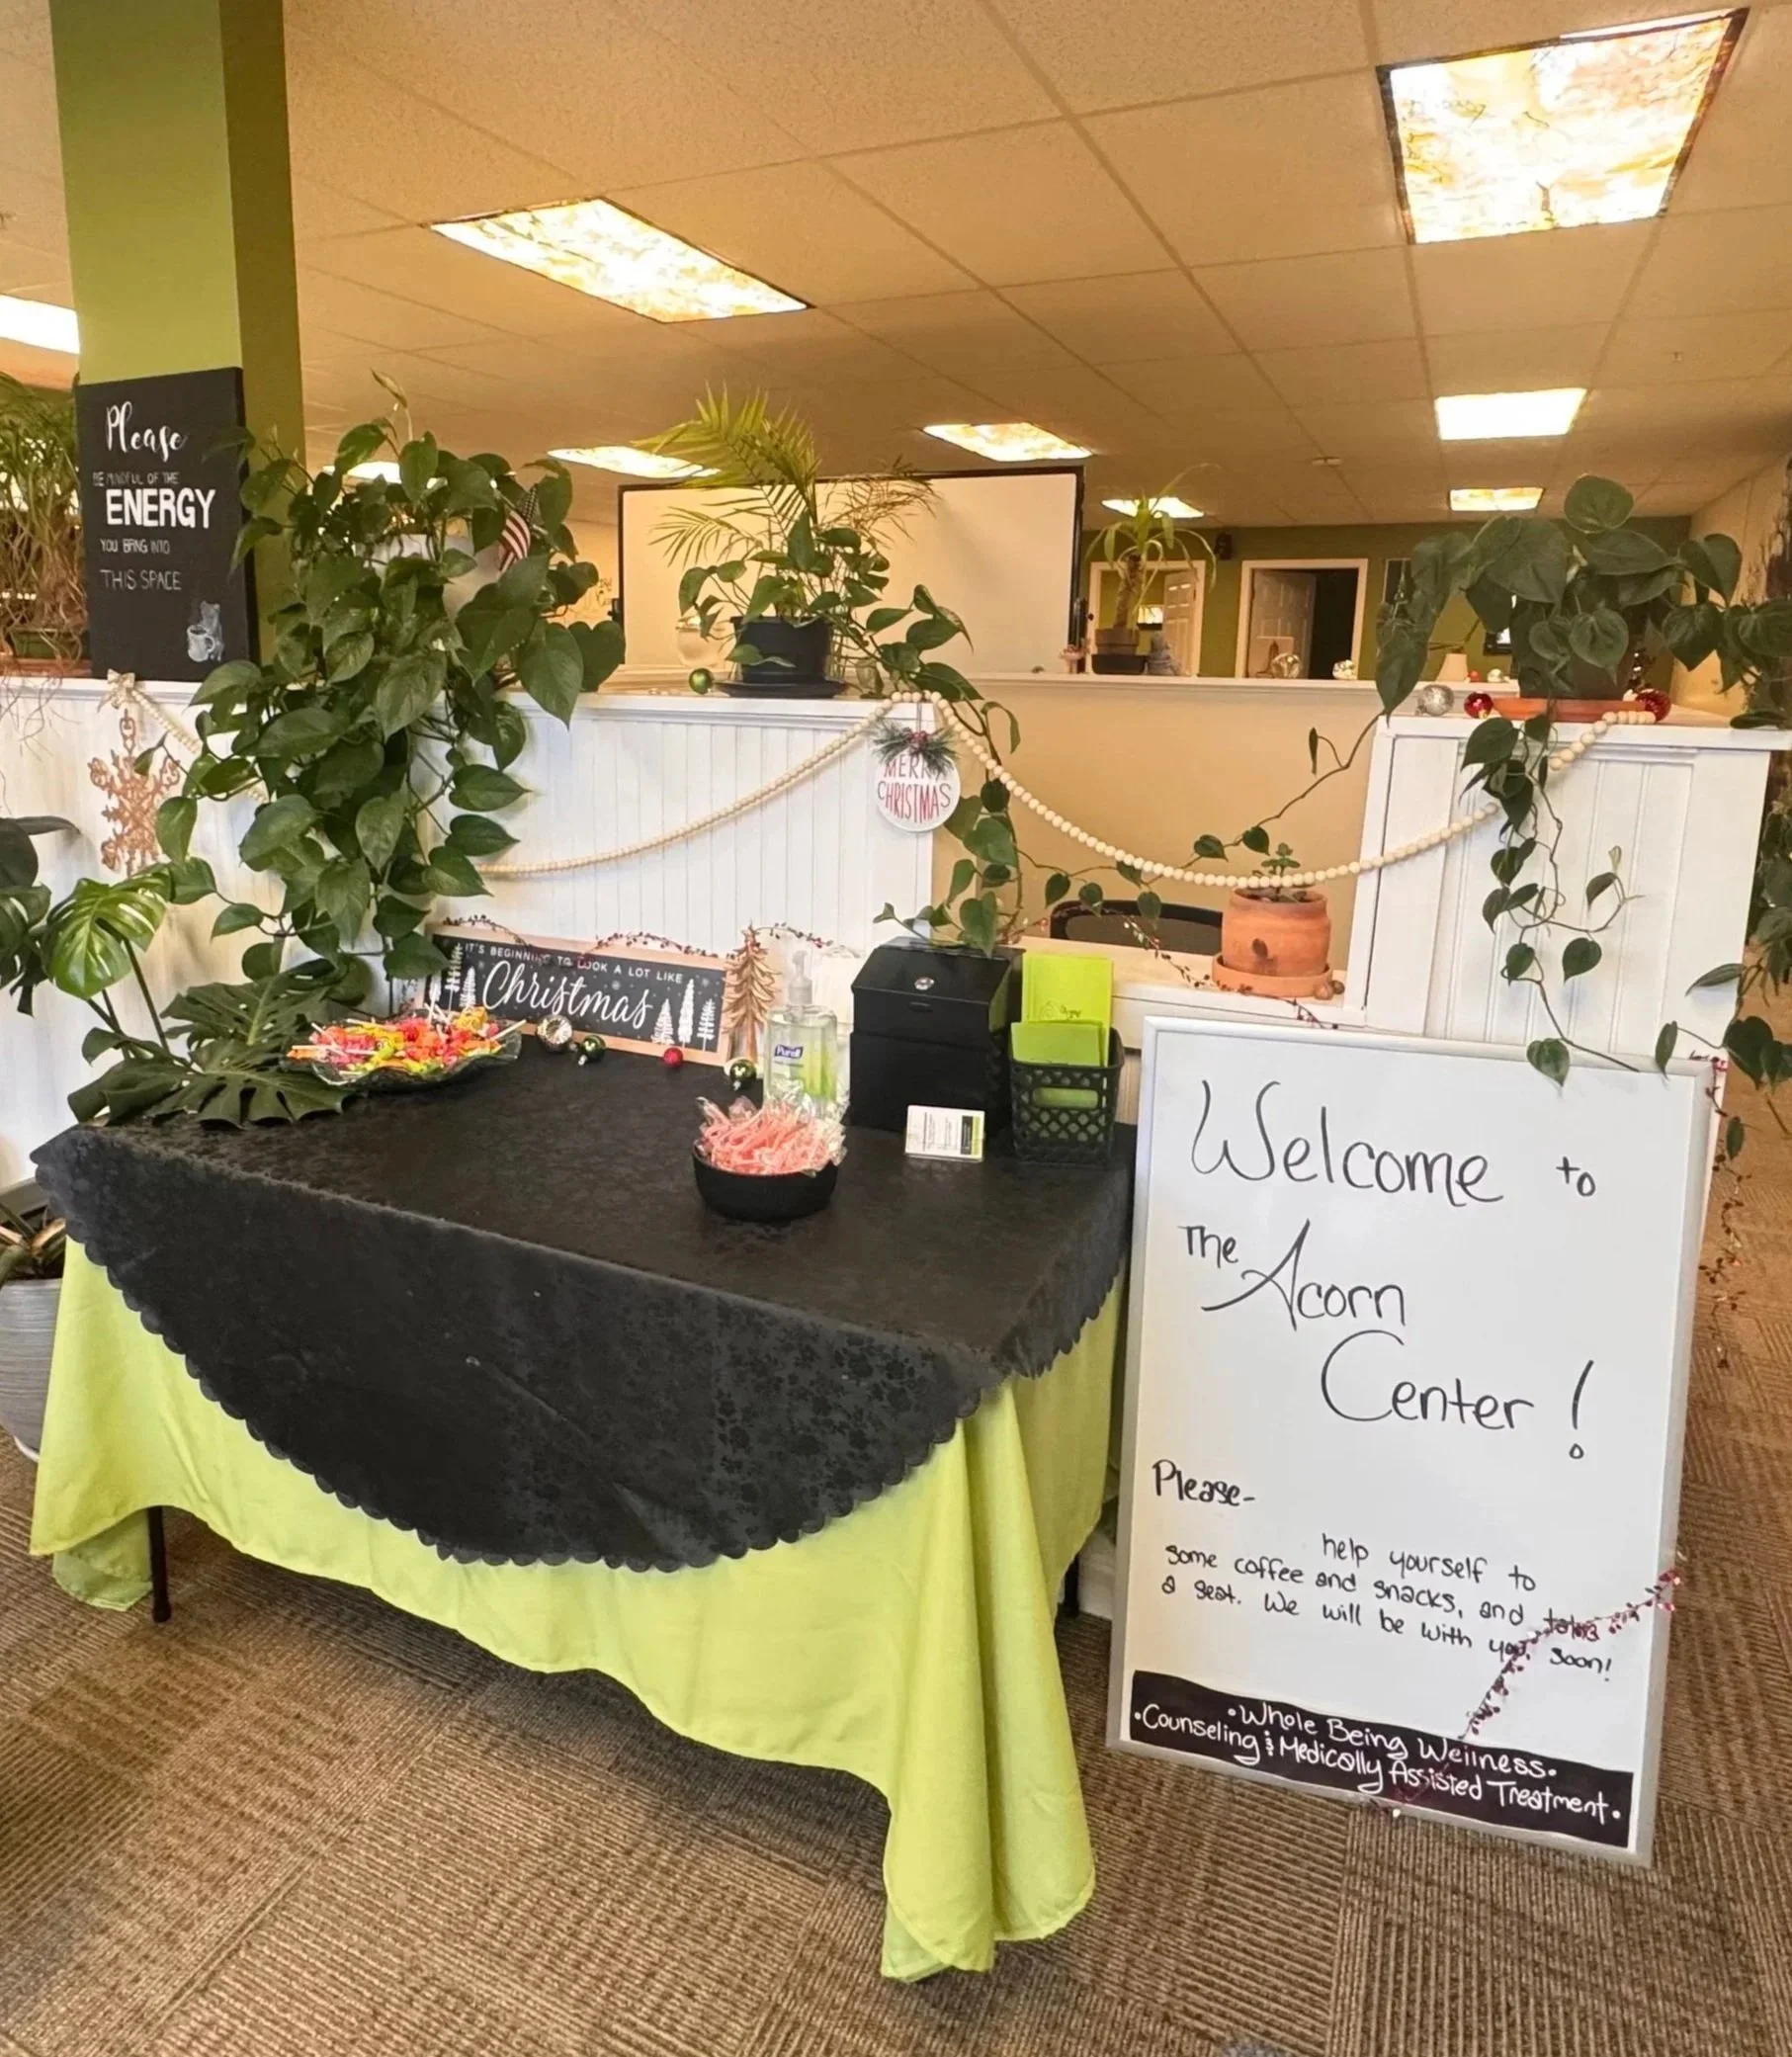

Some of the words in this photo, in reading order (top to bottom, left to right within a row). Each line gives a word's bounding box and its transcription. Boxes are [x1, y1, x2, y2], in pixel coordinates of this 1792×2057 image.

[106, 401, 189, 462] Please
[92, 471, 105, 487] BE
[106, 471, 143, 485] MINDFUL
[147, 471, 159, 485] OF
[161, 471, 180, 485] THE
[106, 487, 216, 529] ENERGY
[100, 538, 119, 554] YOU
[150, 539, 171, 555] INTO
[99, 568, 136, 590] THIS
[139, 569, 182, 590] SPACE
[877, 780, 952, 823] CHRISTMAS
[465, 943, 485, 956] IT'S
[556, 955, 573, 968] TO
[577, 957, 609, 974] LOOK
[614, 964, 623, 976] A
[628, 964, 651, 979] LOT
[655, 970, 683, 985] LIKE
[481, 959, 655, 1030] Christmas
[1191, 1079, 1503, 1207] Welcome
[1556, 1155, 1596, 1198] to
[1178, 1224, 1239, 1269] The
[1200, 1217, 1407, 1331] Acorn
[1322, 1532, 1369, 1569] help
[1389, 1550, 1489, 1584] yourself
[1507, 1565, 1537, 1591] to
[1161, 1575, 1176, 1594] a
[1194, 1579, 1242, 1605] seat.
[1263, 1590, 1300, 1615] We
[1322, 1601, 1362, 1627] will
[1380, 1608, 1405, 1635] be
[1234, 1555, 1305, 1584] coffee
[1315, 1571, 1357, 1592] and
[1373, 1579, 1464, 1619] snacks,
[1479, 1601, 1524, 1626] and
[1326, 1718, 1408, 1760] Being
[1279, 1736, 1384, 1794] Medically
[1388, 1759, 1483, 1800] Assisted
